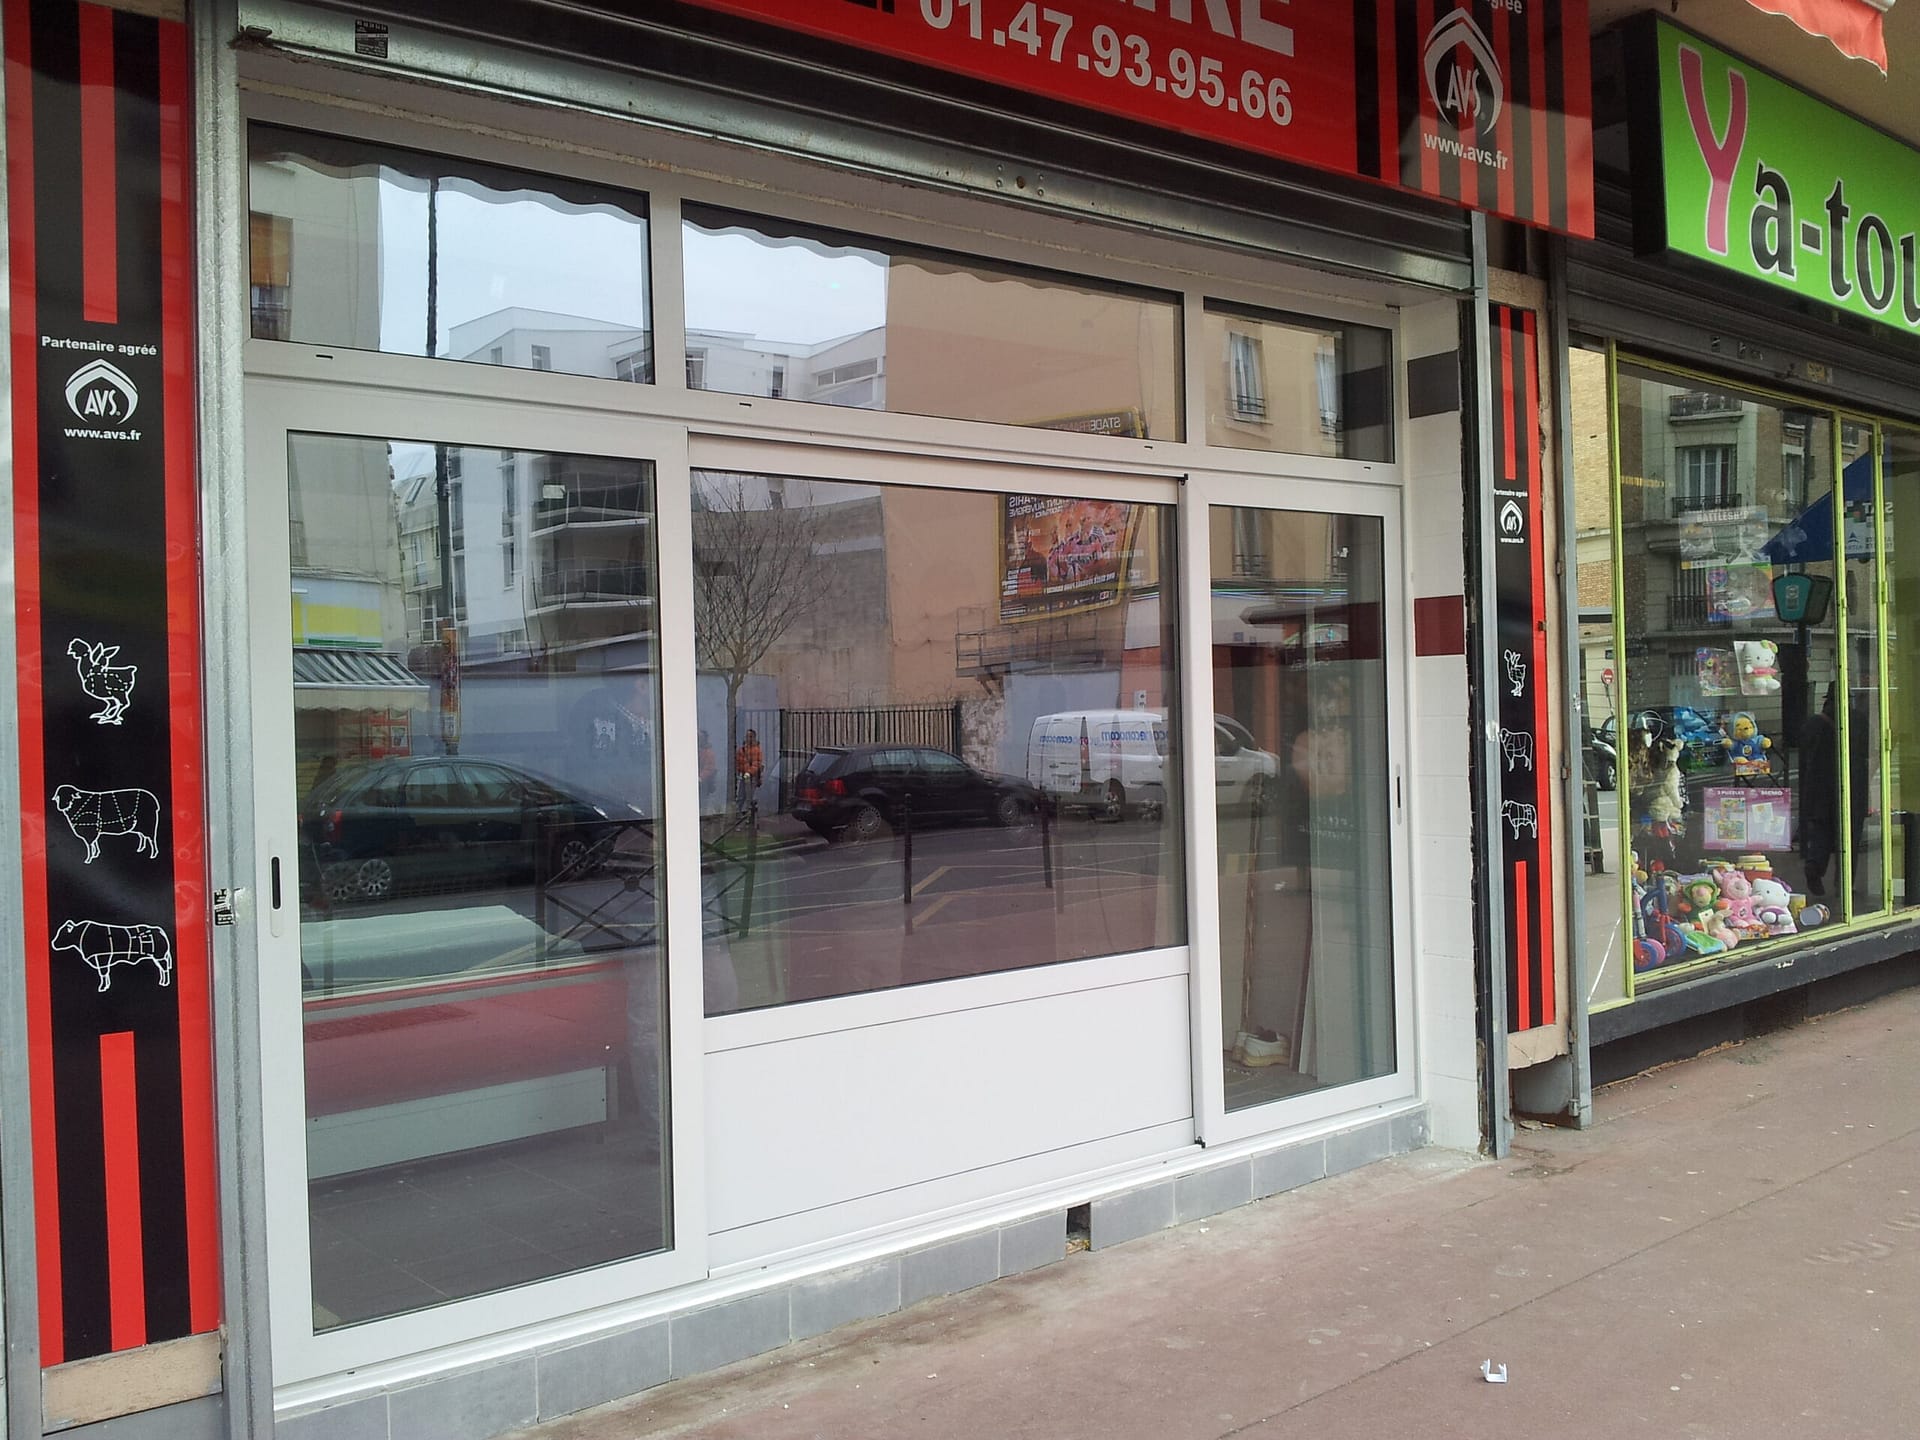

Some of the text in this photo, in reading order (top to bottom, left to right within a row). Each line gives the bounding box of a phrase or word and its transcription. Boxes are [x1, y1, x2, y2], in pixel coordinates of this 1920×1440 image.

[919, 0, 1293, 126] 01.47.93.95.66
[1446, 63, 1481, 119] AVS
[1424, 133, 1508, 170] www.avs.fr
[41, 336, 157, 356] Partenaire agréé
[84, 389, 118, 418] AVS
[64, 428, 141, 440] www.avs.fr
